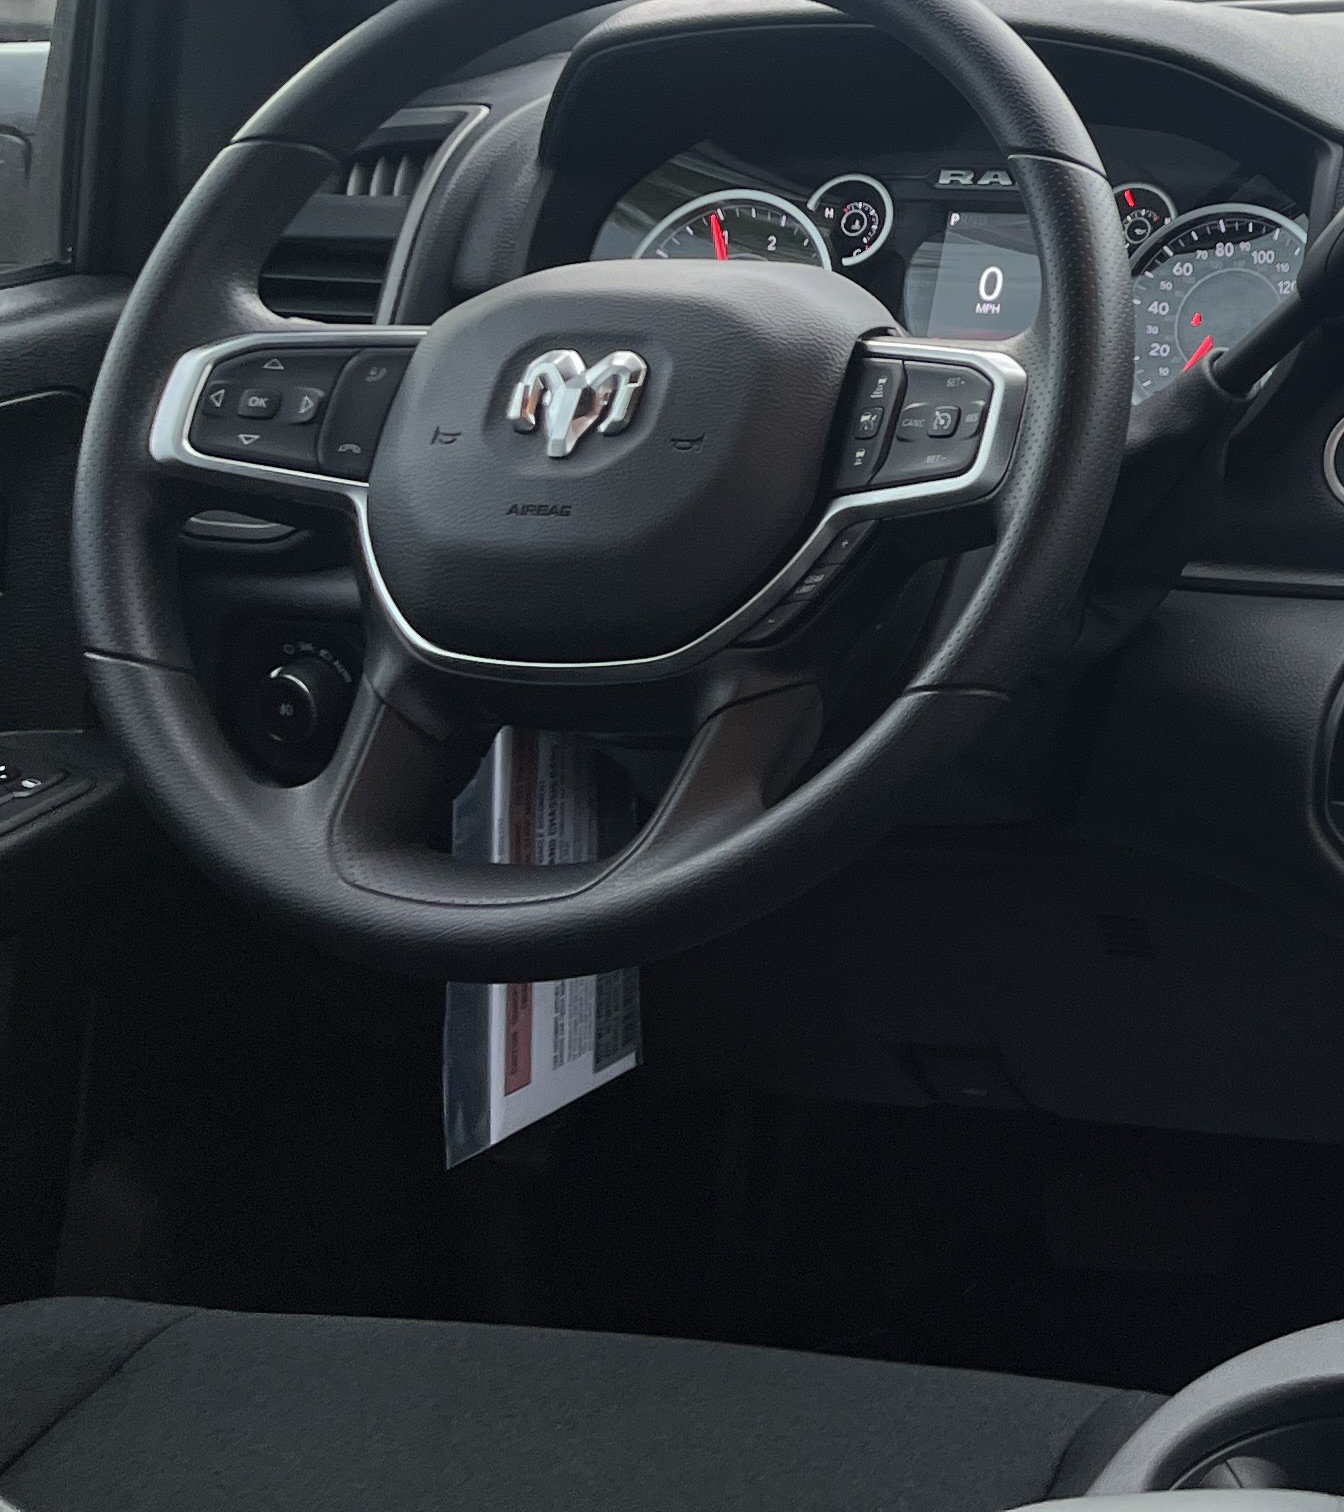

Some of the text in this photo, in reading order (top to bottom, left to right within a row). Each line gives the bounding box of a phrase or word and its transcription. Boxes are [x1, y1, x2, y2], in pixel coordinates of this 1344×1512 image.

[938, 169, 1013, 186] RA
[825, 207, 834, 219] H
[950, 212, 961, 227] P
[767, 235, 777, 250] 2
[1239, 241, 1251, 252] 90
[1196, 250, 1209, 260] 70
[1215, 242, 1234, 257] 80
[1251, 250, 1275, 264] 100
[1172, 262, 1193, 277] 60
[978, 266, 1003, 301] 0
[1160, 281, 1173, 291] 50
[975, 302, 1000, 315] MPH
[1148, 301, 1169, 315] 40
[1146, 325, 1159, 335] 30
[1149, 343, 1170, 357] 20
[1158, 366, 1170, 377] 10
[248, 396, 268, 408] OK
[902, 417, 925, 428] CANC
[506, 504, 572, 517] AIRBAG
